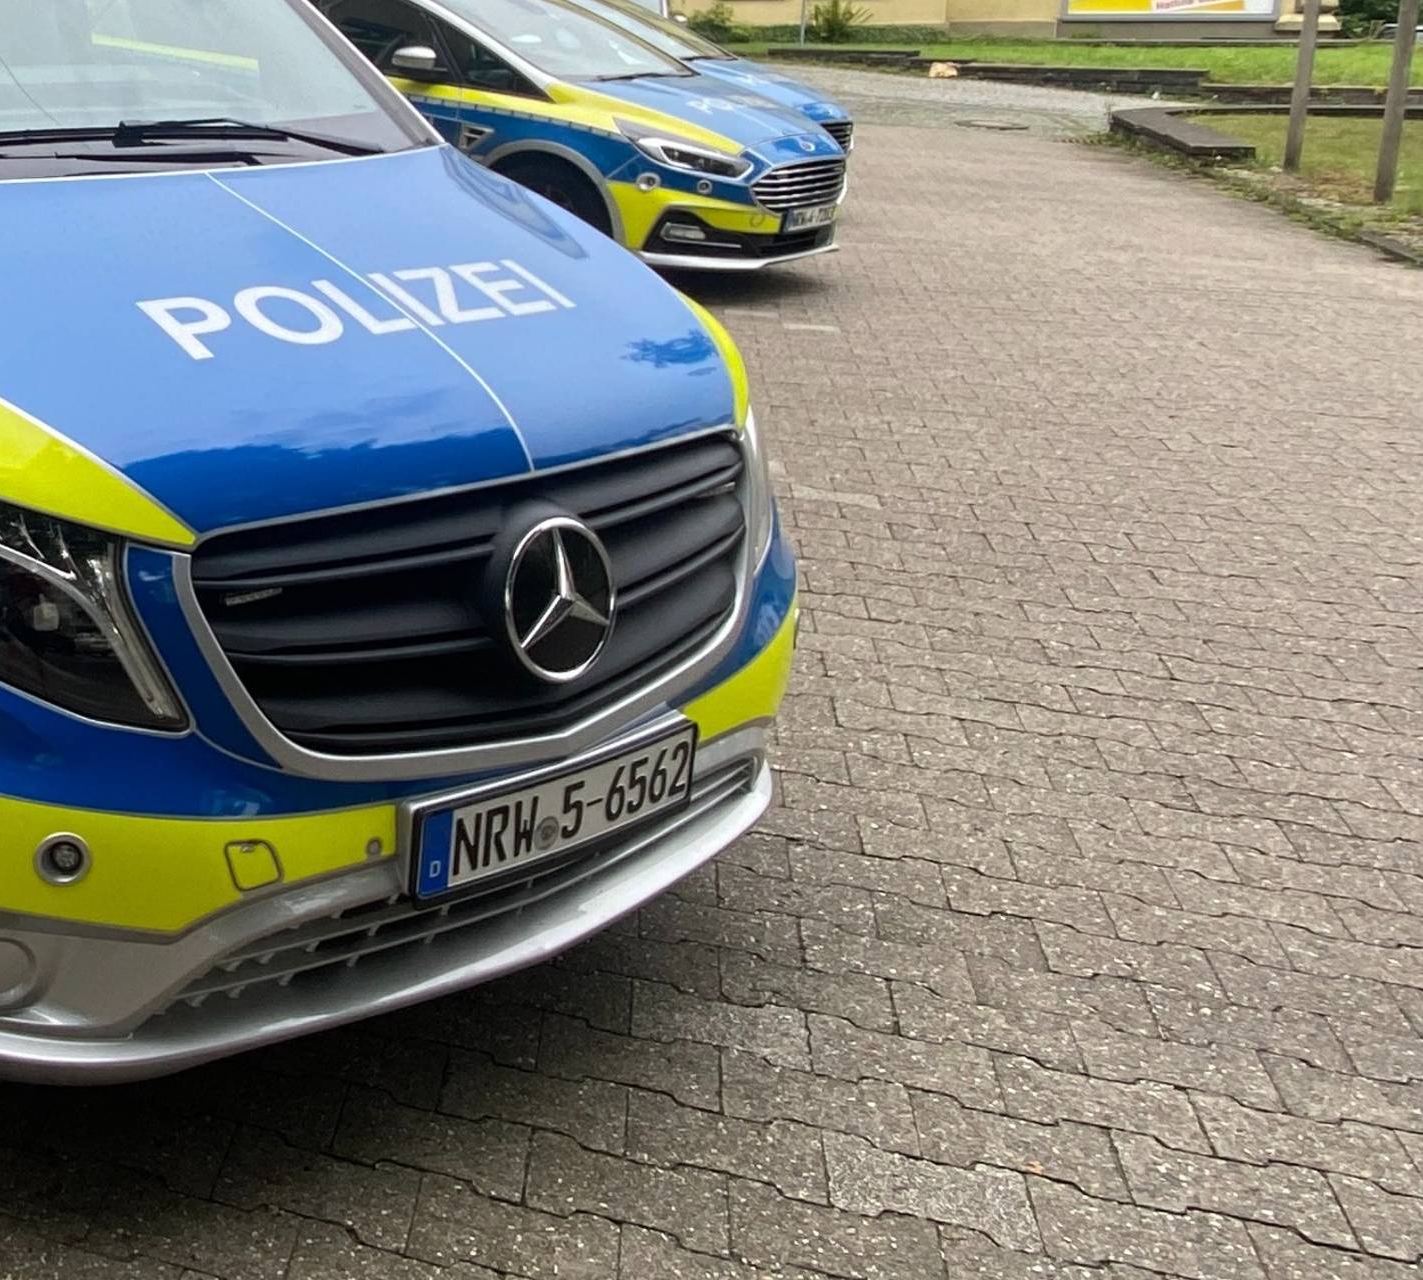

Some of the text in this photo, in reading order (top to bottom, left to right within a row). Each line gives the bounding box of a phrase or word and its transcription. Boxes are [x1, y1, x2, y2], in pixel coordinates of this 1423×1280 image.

[136, 258, 577, 361] POLIZEI
[452, 741, 689, 876] NRW 5-6562
